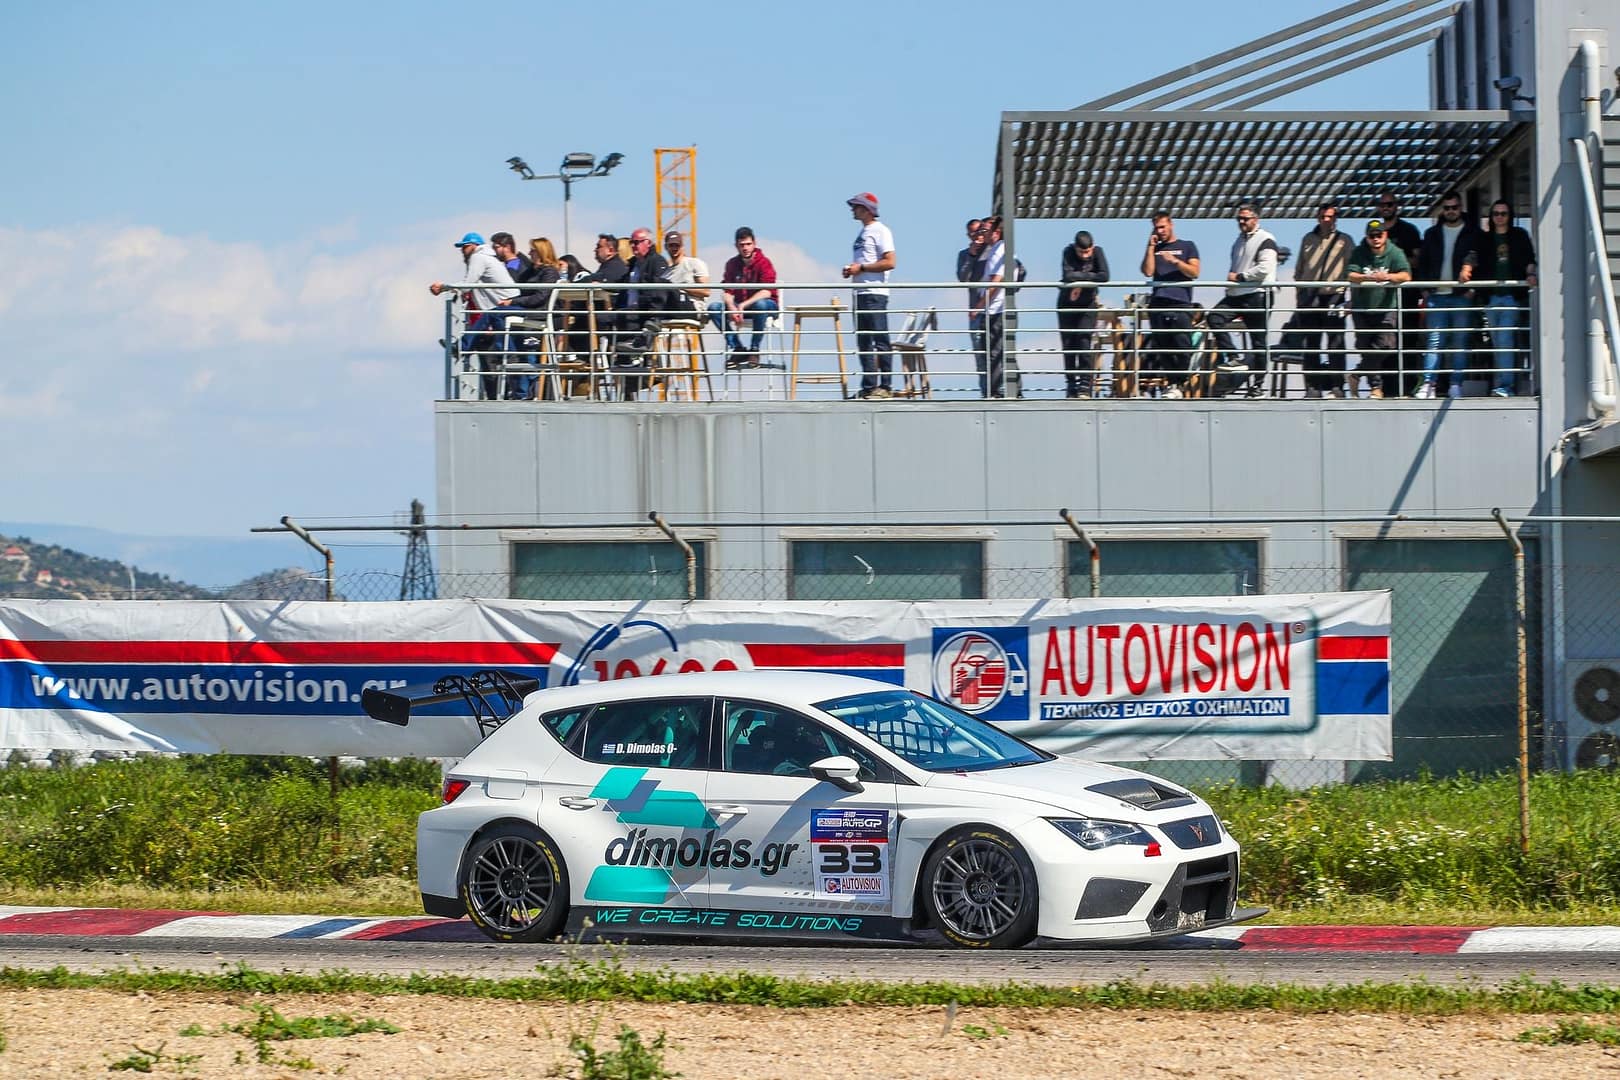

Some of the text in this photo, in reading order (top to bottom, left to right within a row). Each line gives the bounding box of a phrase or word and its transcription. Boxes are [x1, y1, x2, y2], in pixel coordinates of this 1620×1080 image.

[1040, 621, 1290, 697] AUTOVISION
[1043, 699, 1286, 719] ΤΕΧΝΙΚΟΣ ΕΛΕΓΧΟΣ ΟΧΗΜΑΤΩΝ
[616, 743, 625, 754] D.
[626, 742, 666, 754] Dimolas
[604, 827, 799, 876] dimolas.gr
[819, 844, 882, 874] 33
[842, 877, 881, 890] AUTOVISION
[596, 909, 863, 932] WE CREATE SOLUTIONS
